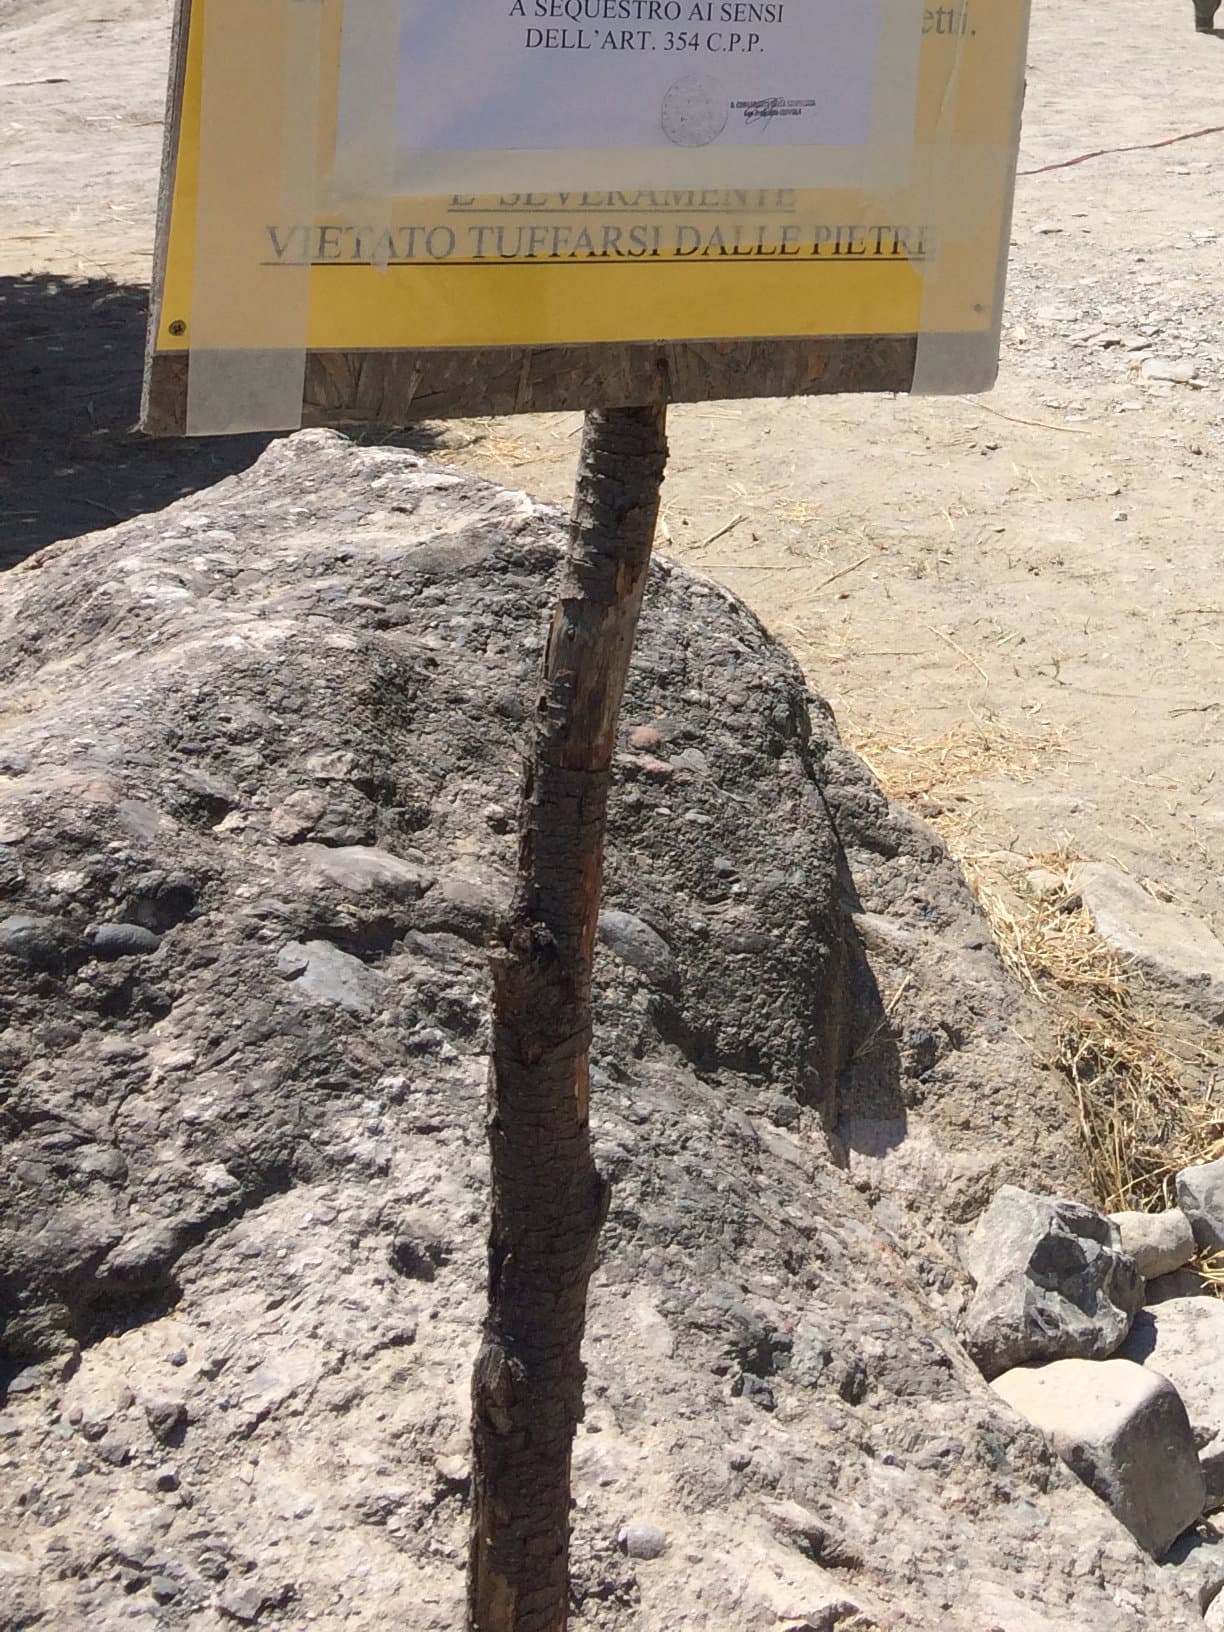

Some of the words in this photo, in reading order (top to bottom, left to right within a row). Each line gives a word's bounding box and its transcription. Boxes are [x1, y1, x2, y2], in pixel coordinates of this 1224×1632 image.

[688, 2, 713, 21] AI
[720, 2, 784, 23] SENSI
[525, 28, 656, 51] DELL'ART.
[663, 31, 700, 52] 354
[706, 32, 765, 52] C.P.P.
[266, 225, 456, 259] VIETATO
[468, 225, 661, 258] TUFFARSI
[673, 224, 800, 257] DALLE
